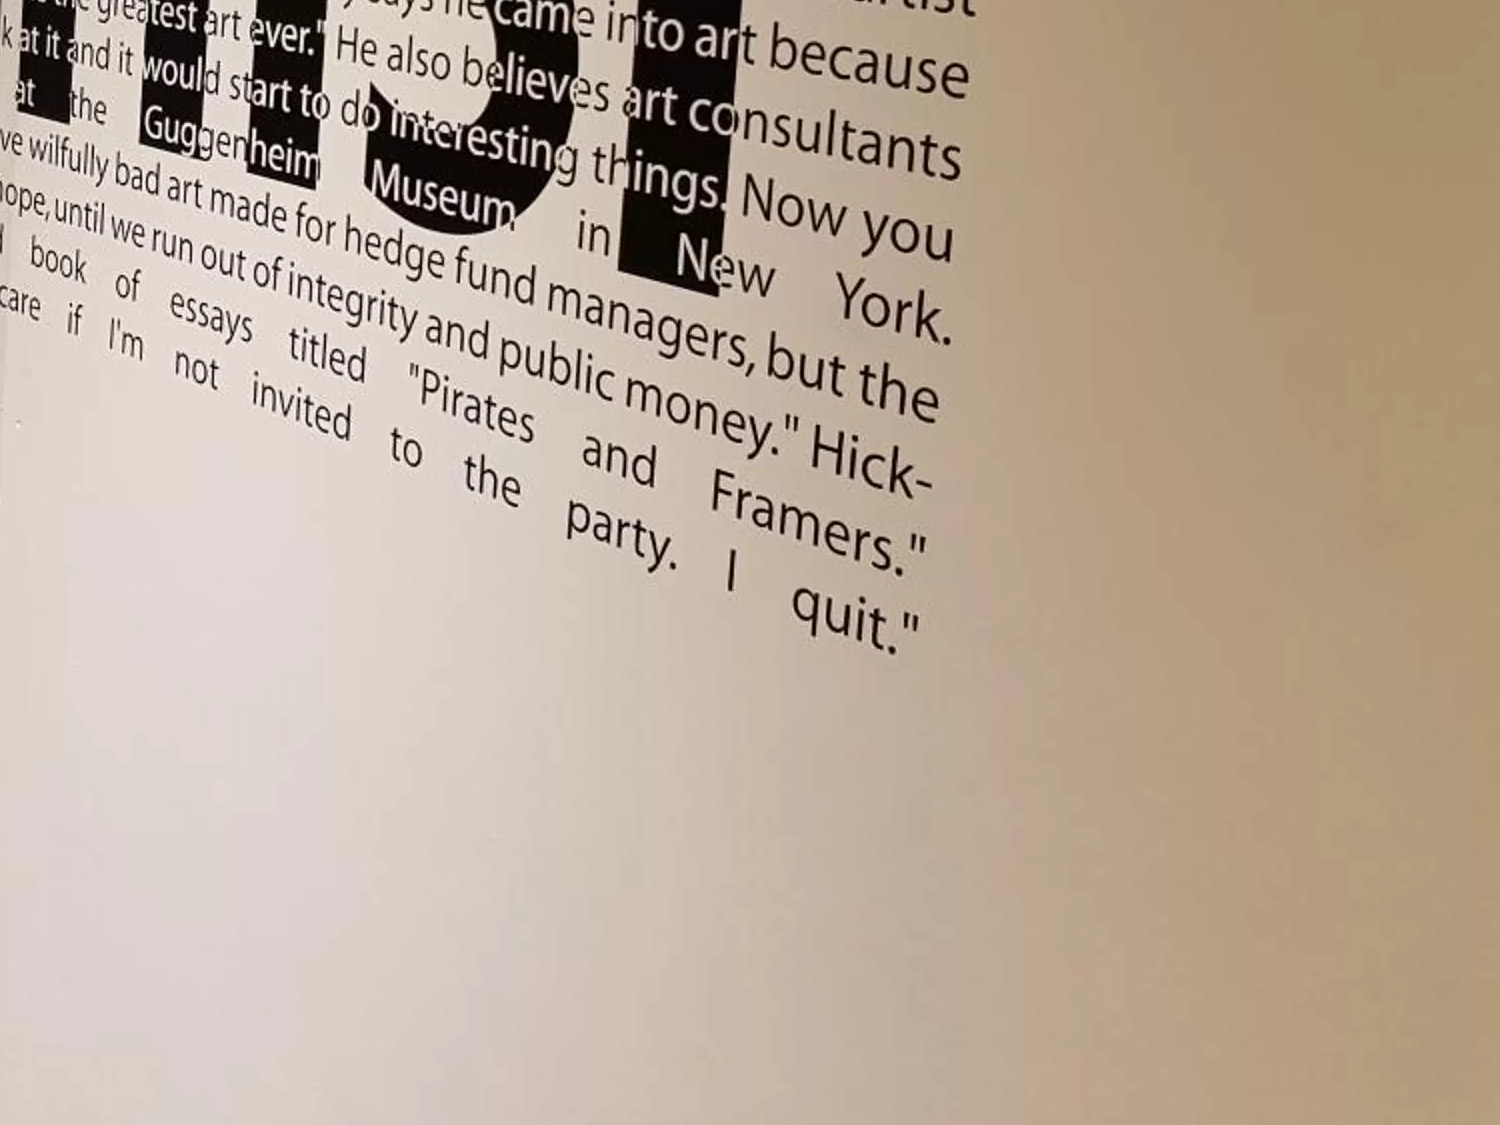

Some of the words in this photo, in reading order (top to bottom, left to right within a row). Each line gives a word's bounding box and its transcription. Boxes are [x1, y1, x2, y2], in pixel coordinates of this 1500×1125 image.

[687, 97, 963, 183] consultants
[769, 21, 971, 101] because
[28, 132, 108, 191] wilfully
[115, 149, 160, 196] bad
[167, 174, 203, 209] art
[210, 186, 287, 234] made
[294, 199, 336, 248] for
[344, 212, 445, 285] hedge
[454, 243, 537, 307] fund
[547, 280, 755, 379] managers,
[767, 329, 847, 398] but
[857, 359, 941, 425] the
[54, 196, 105, 236] until
[110, 214, 145, 249] we
[151, 227, 194, 265] run
[200, 242, 246, 282] out
[252, 253, 280, 293] of
[287, 260, 417, 348] integrity
[425, 312, 490, 361] and
[498, 335, 614, 401] public
[625, 375, 799, 463] money."
[811, 422, 932, 499] Hick-
[144, 103, 321, 182] Guggenheim
[370, 158, 517, 233] Museum
[577, 208, 610, 257] in
[832, 271, 951, 347] York.
[30, 232, 87, 284] book
[115, 266, 141, 304] of
[170, 290, 253, 349] essays
[288, 325, 367, 384] titled
[409, 360, 535, 444] "Pirates
[582, 431, 658, 487] and
[710, 465, 927, 575] Framers."
[67, 301, 83, 338] if
[109, 317, 143, 361] I'm
[174, 349, 219, 391] not
[251, 369, 352, 442] invited
[389, 425, 423, 470] to
[463, 450, 522, 508] the
[566, 496, 677, 577] party.
[727, 546, 735, 590] I
[790, 580, 920, 652] quit."
